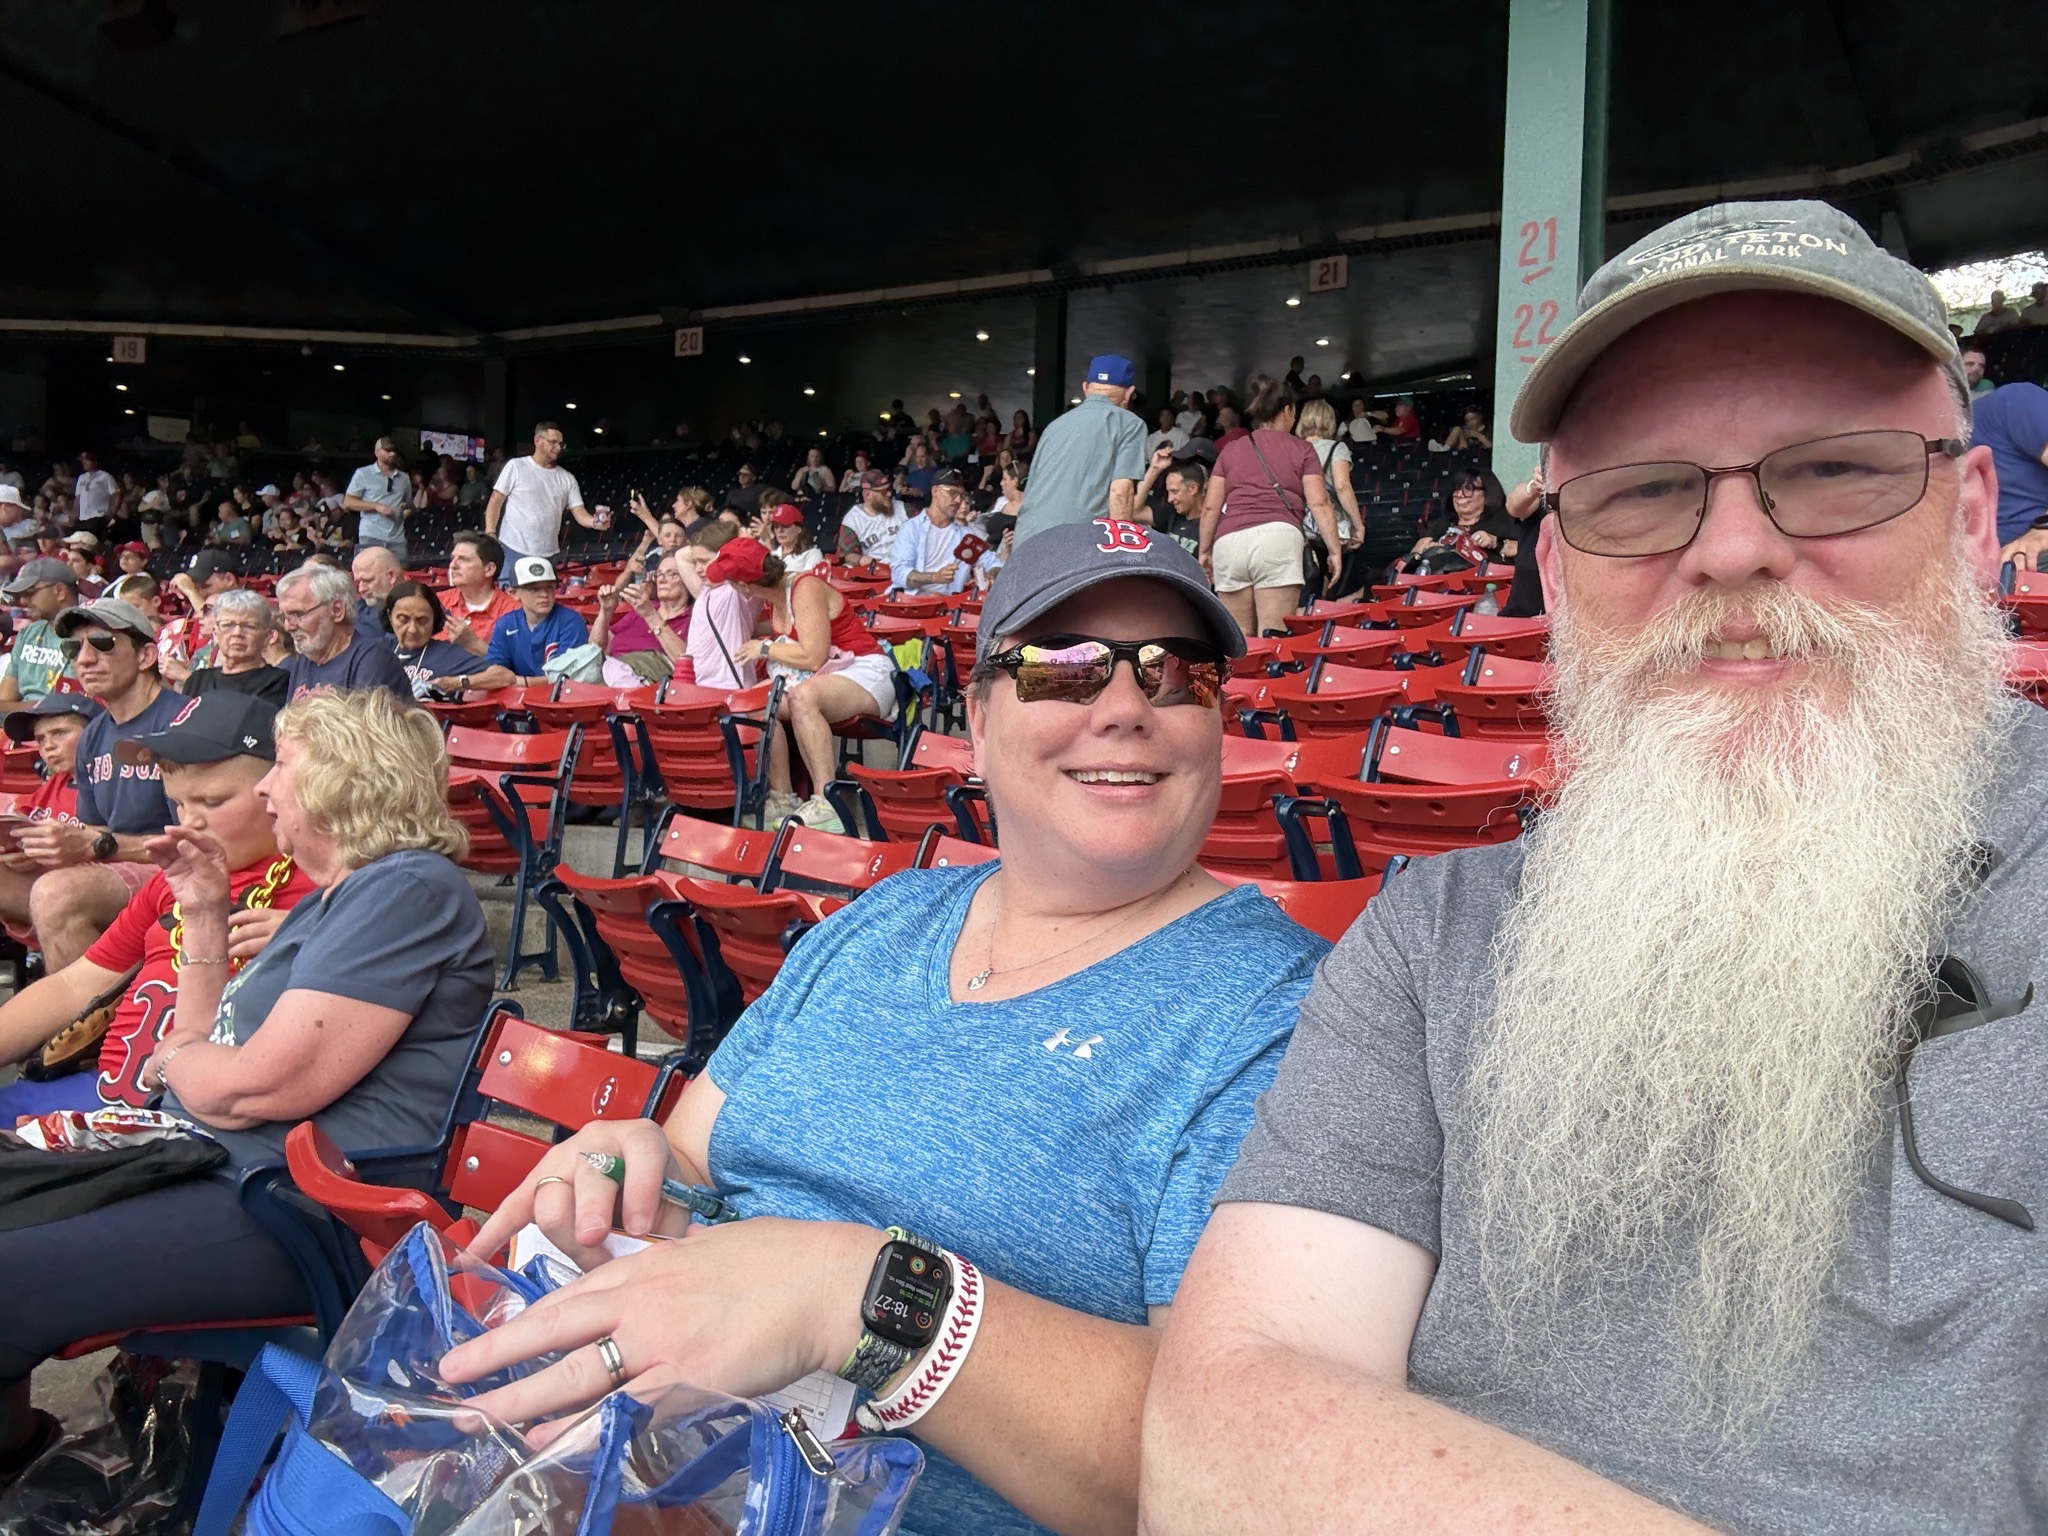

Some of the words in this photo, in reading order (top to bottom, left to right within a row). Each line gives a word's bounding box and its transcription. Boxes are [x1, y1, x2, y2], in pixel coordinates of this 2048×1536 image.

[1518, 216, 1557, 267] 21
[1721, 231, 1848, 256] TETON
[1740, 244, 1803, 259] PARK
[1318, 261, 1339, 286] 21
[1512, 299, 1559, 349] 22
[121, 340, 138, 359] 19
[679, 332, 699, 353] 20
[1092, 518, 1154, 553] B
[599, 1084, 613, 1107] 3
[874, 1294, 909, 1318] 18:27
